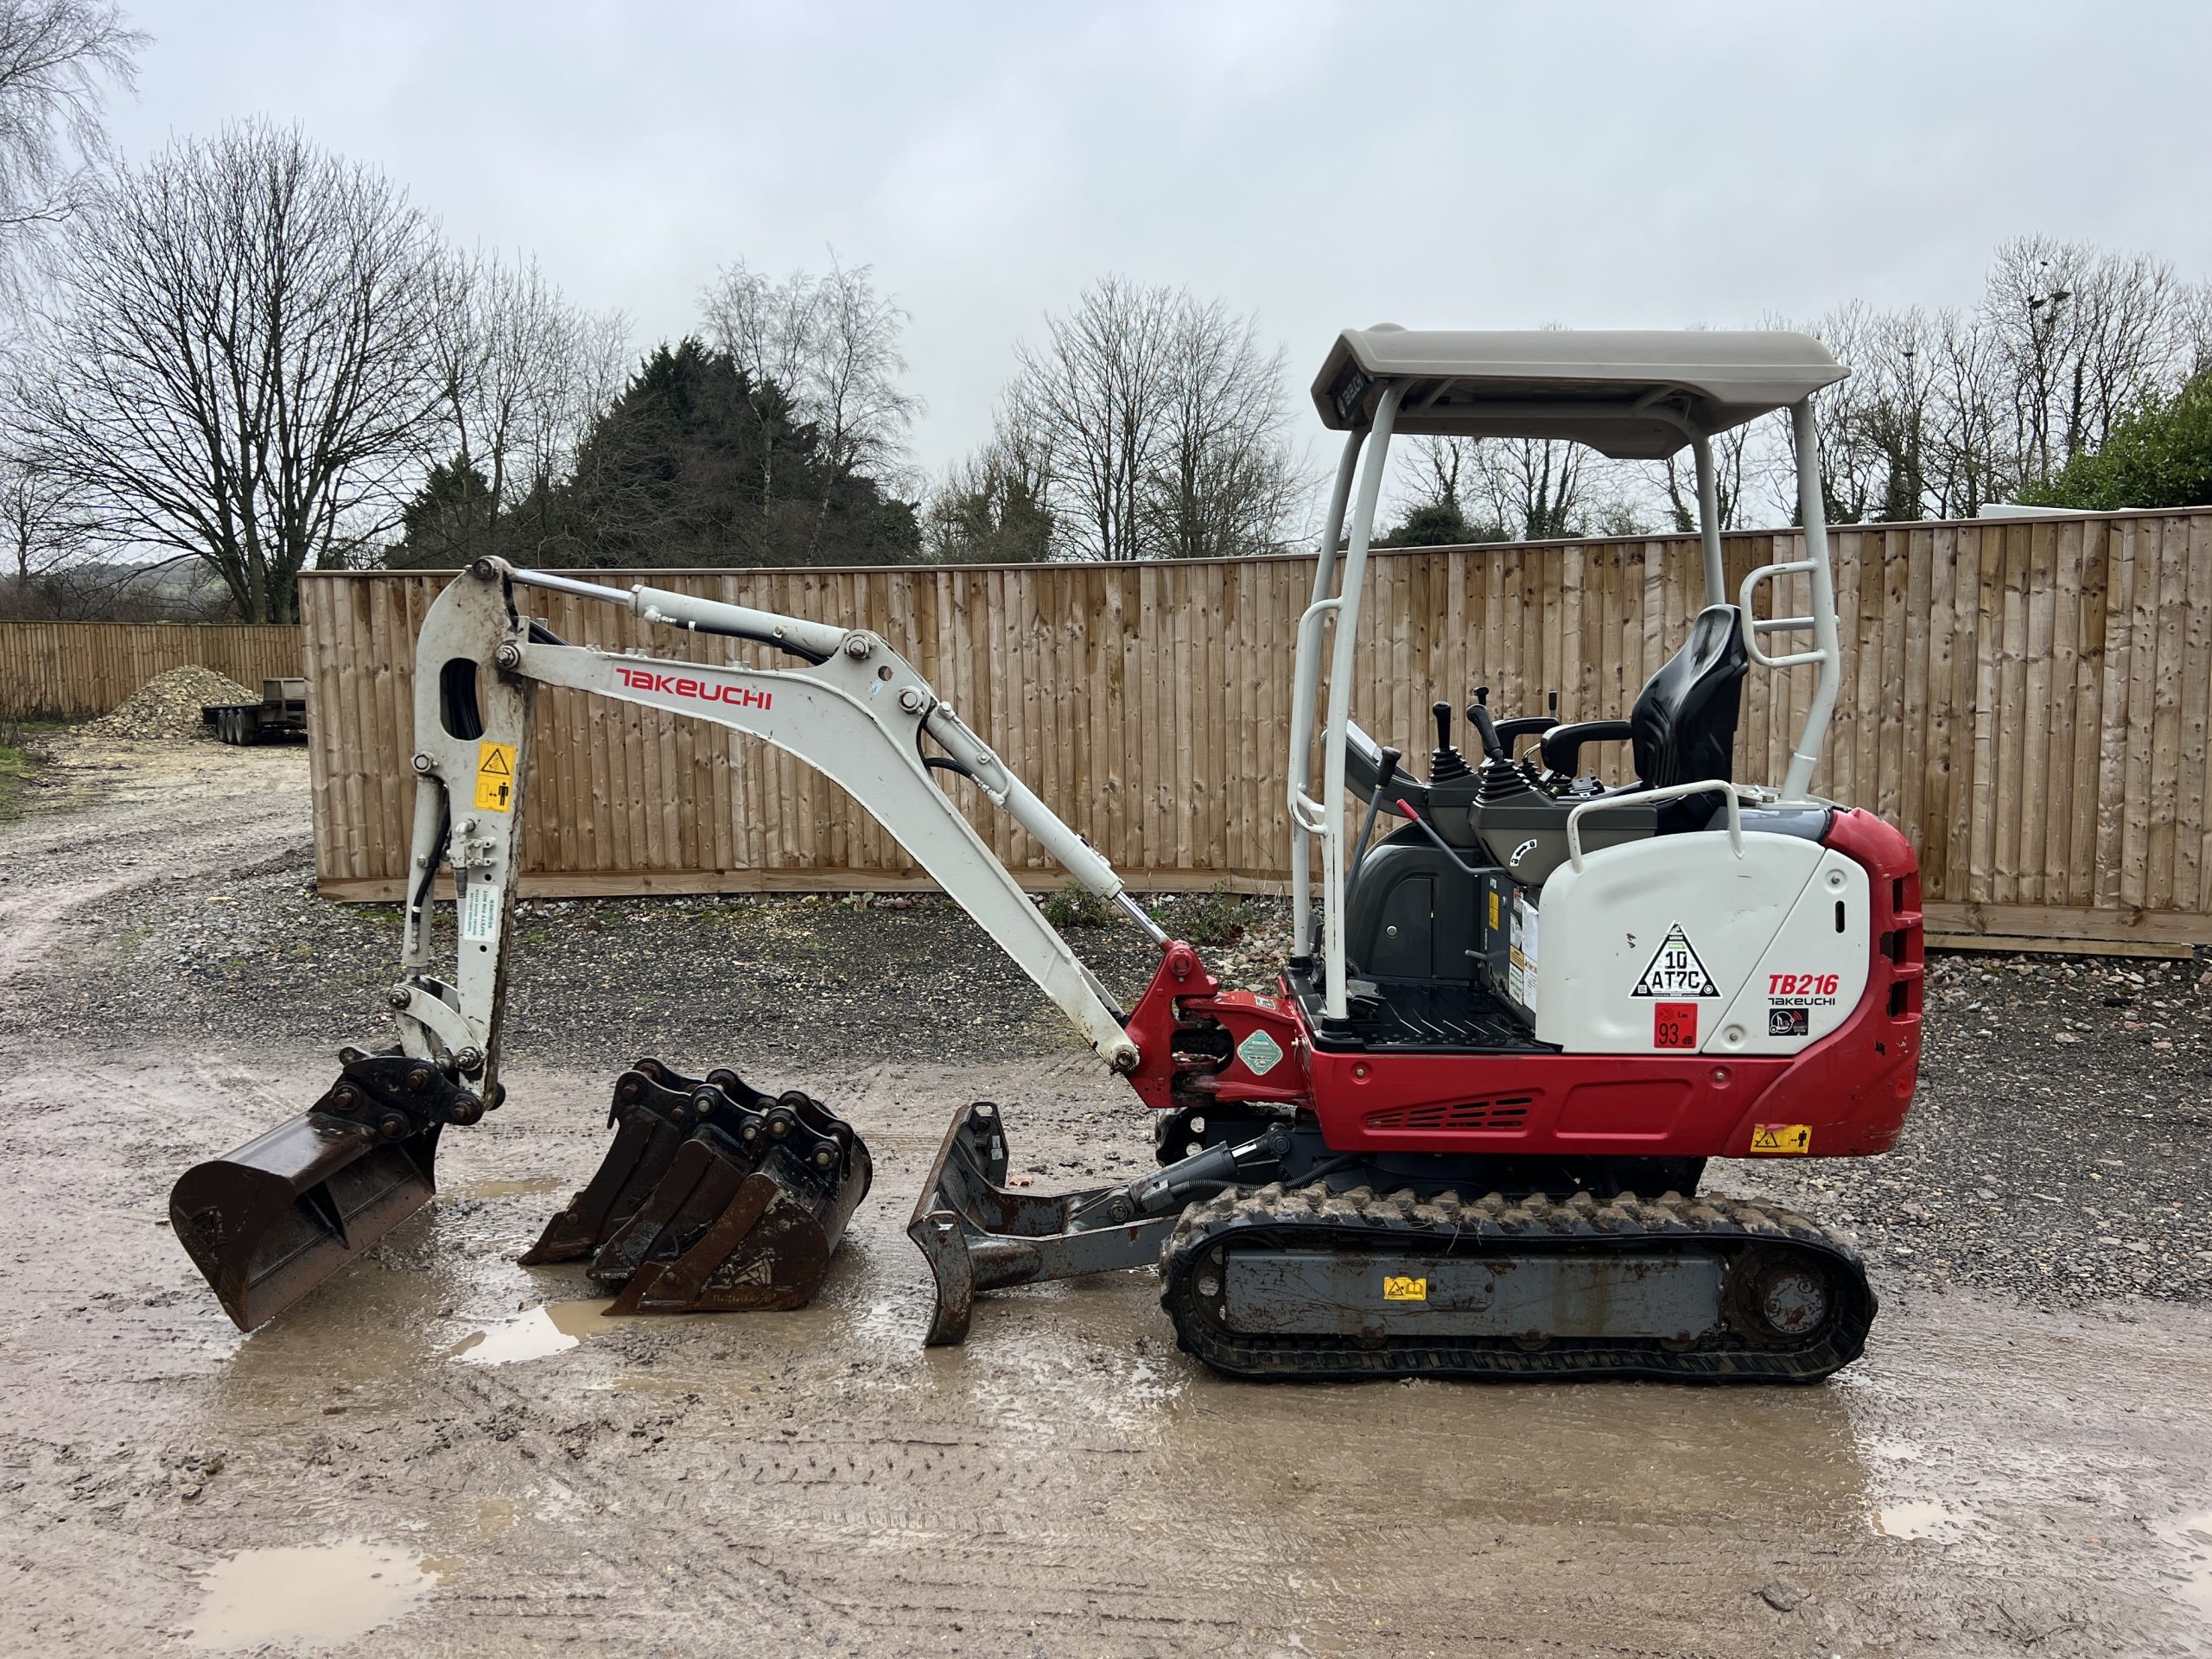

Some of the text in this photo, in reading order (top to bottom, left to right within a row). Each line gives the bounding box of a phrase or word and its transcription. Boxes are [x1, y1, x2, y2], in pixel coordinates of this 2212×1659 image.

[1651, 971, 1700, 989] AT7C
[1769, 974, 1840, 995] TB216
[1658, 1022, 1693, 1045] 93 dB
